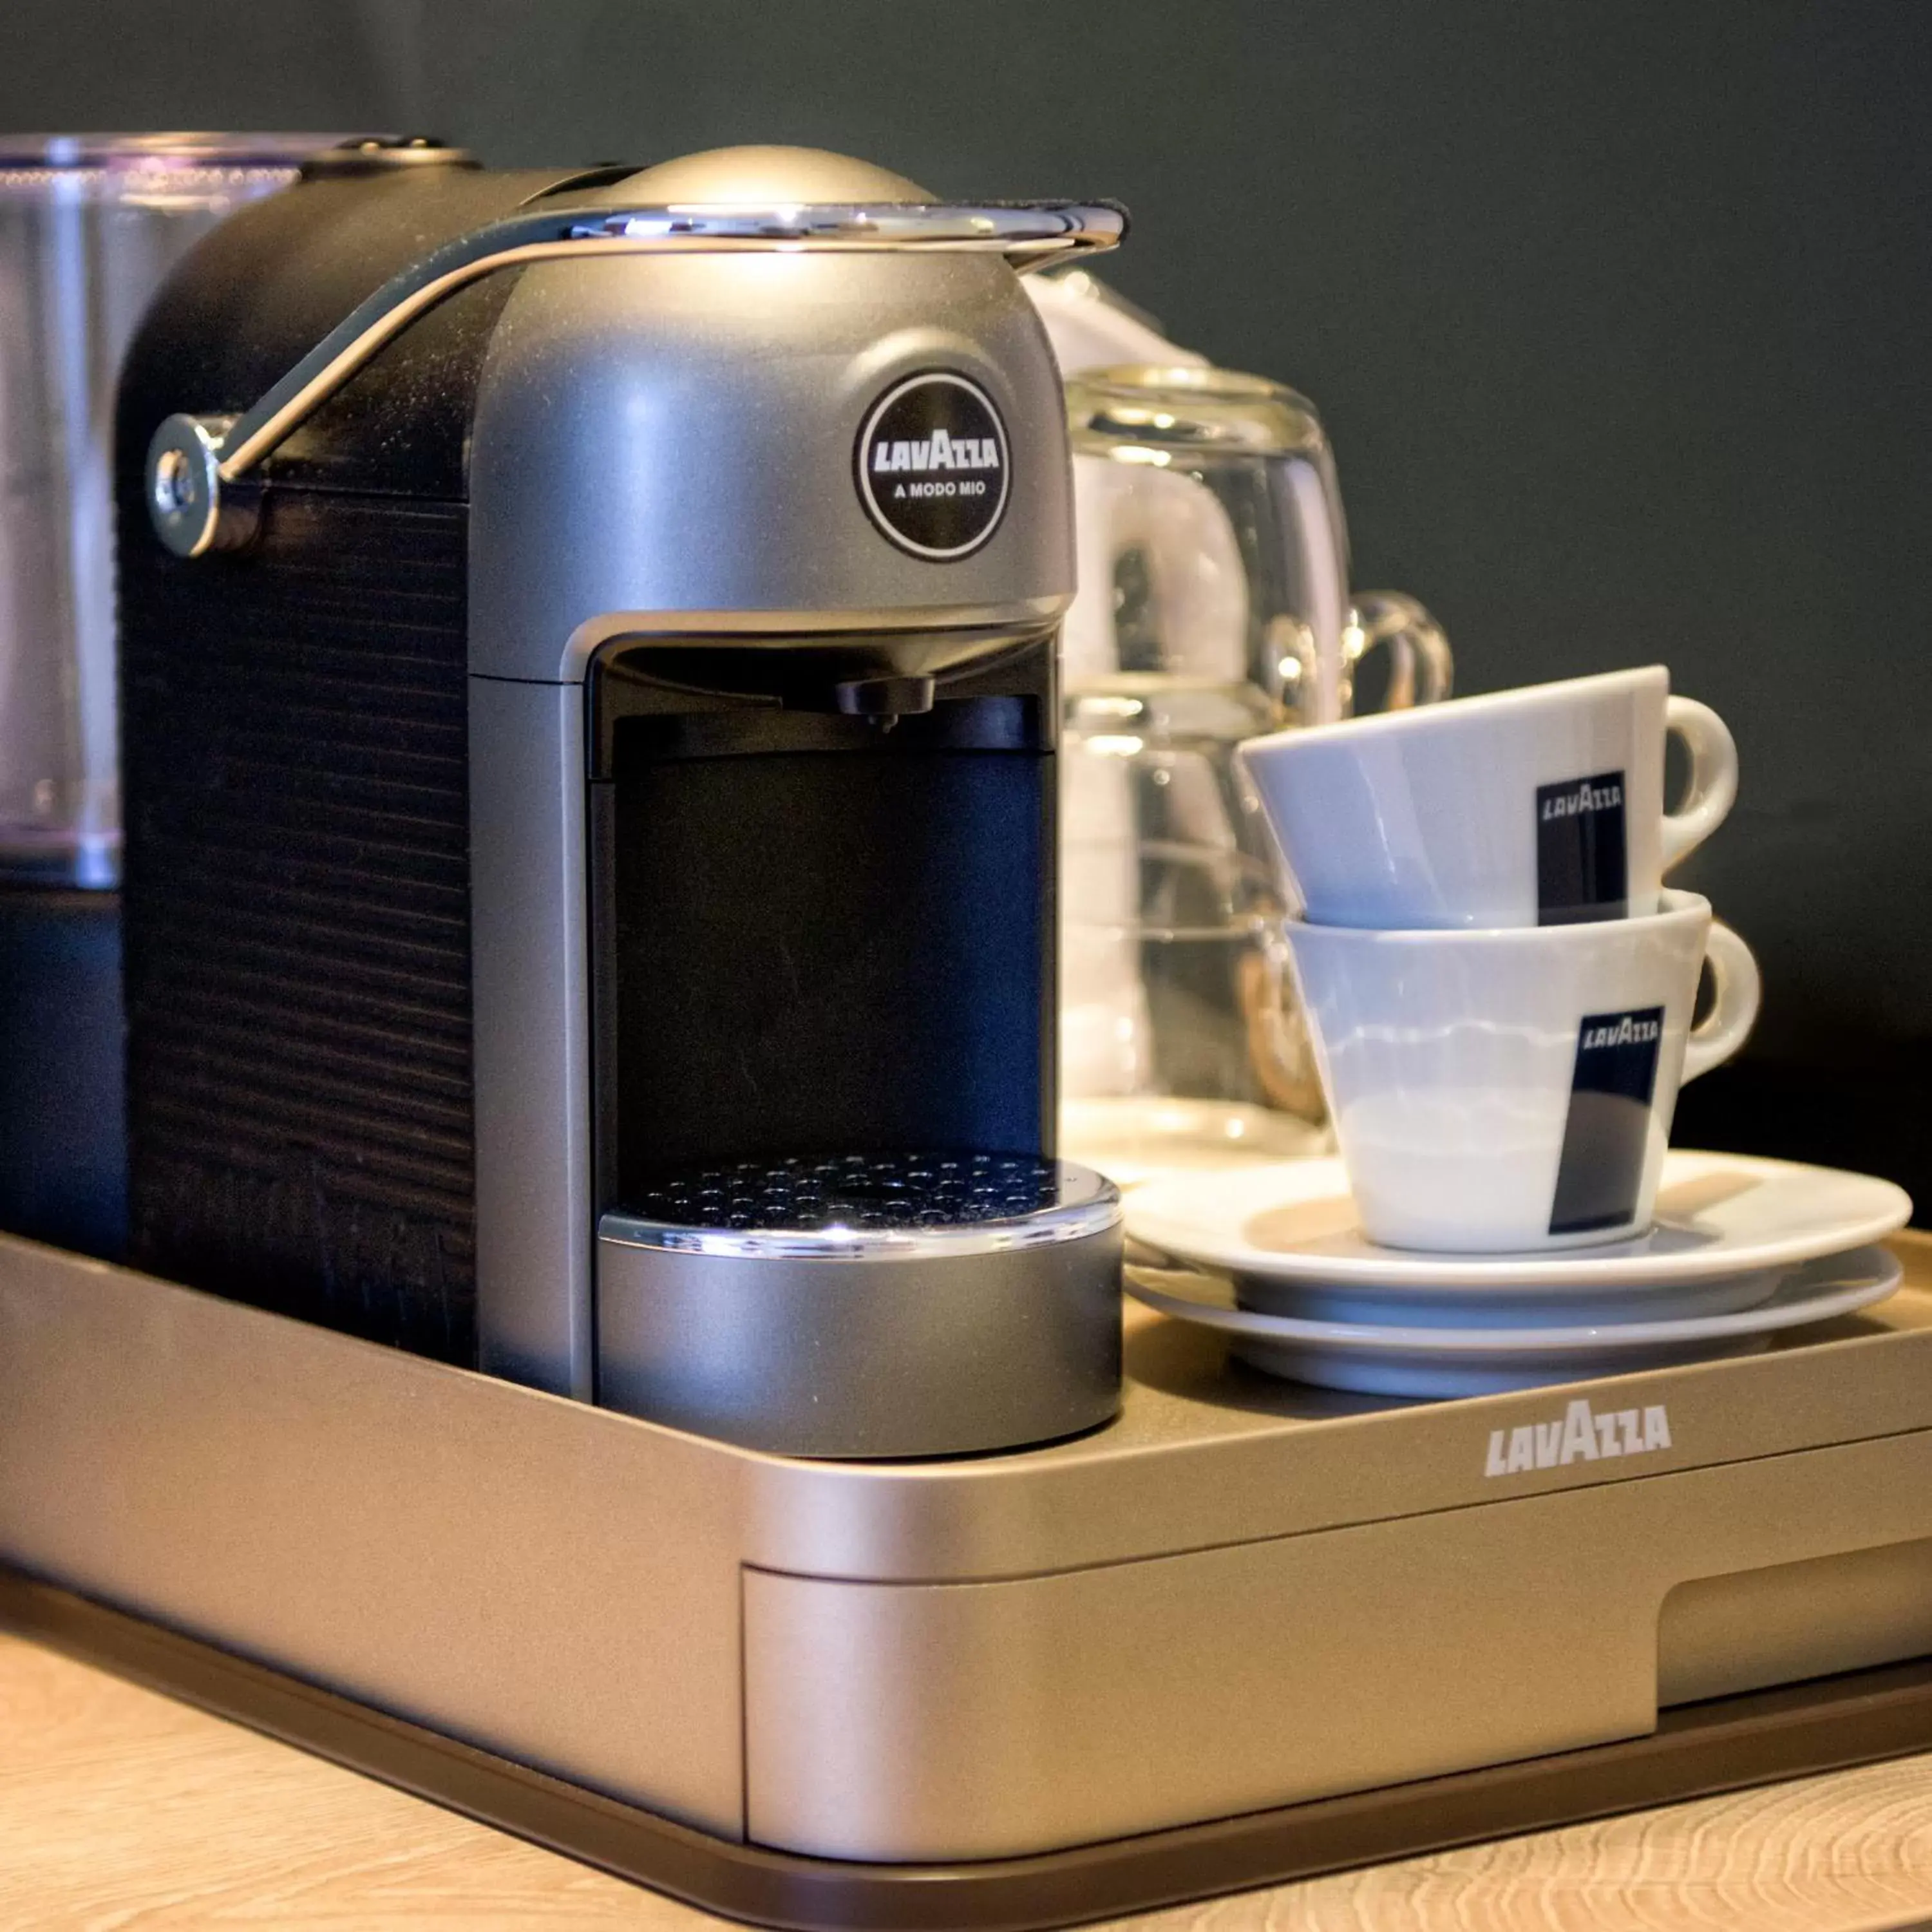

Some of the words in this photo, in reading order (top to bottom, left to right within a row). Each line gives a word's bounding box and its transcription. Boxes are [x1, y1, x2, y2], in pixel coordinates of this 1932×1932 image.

[874, 429, 999, 471] LAVAZZA
[895, 484, 906, 498] A
[910, 482, 956, 498] MODO
[960, 481, 986, 495] MIO
[1543, 784, 1622, 820] LAVAZZA
[1584, 1017, 1658, 1050] LAVAZZA
[1484, 1399, 1672, 1477] LAVAZZA
